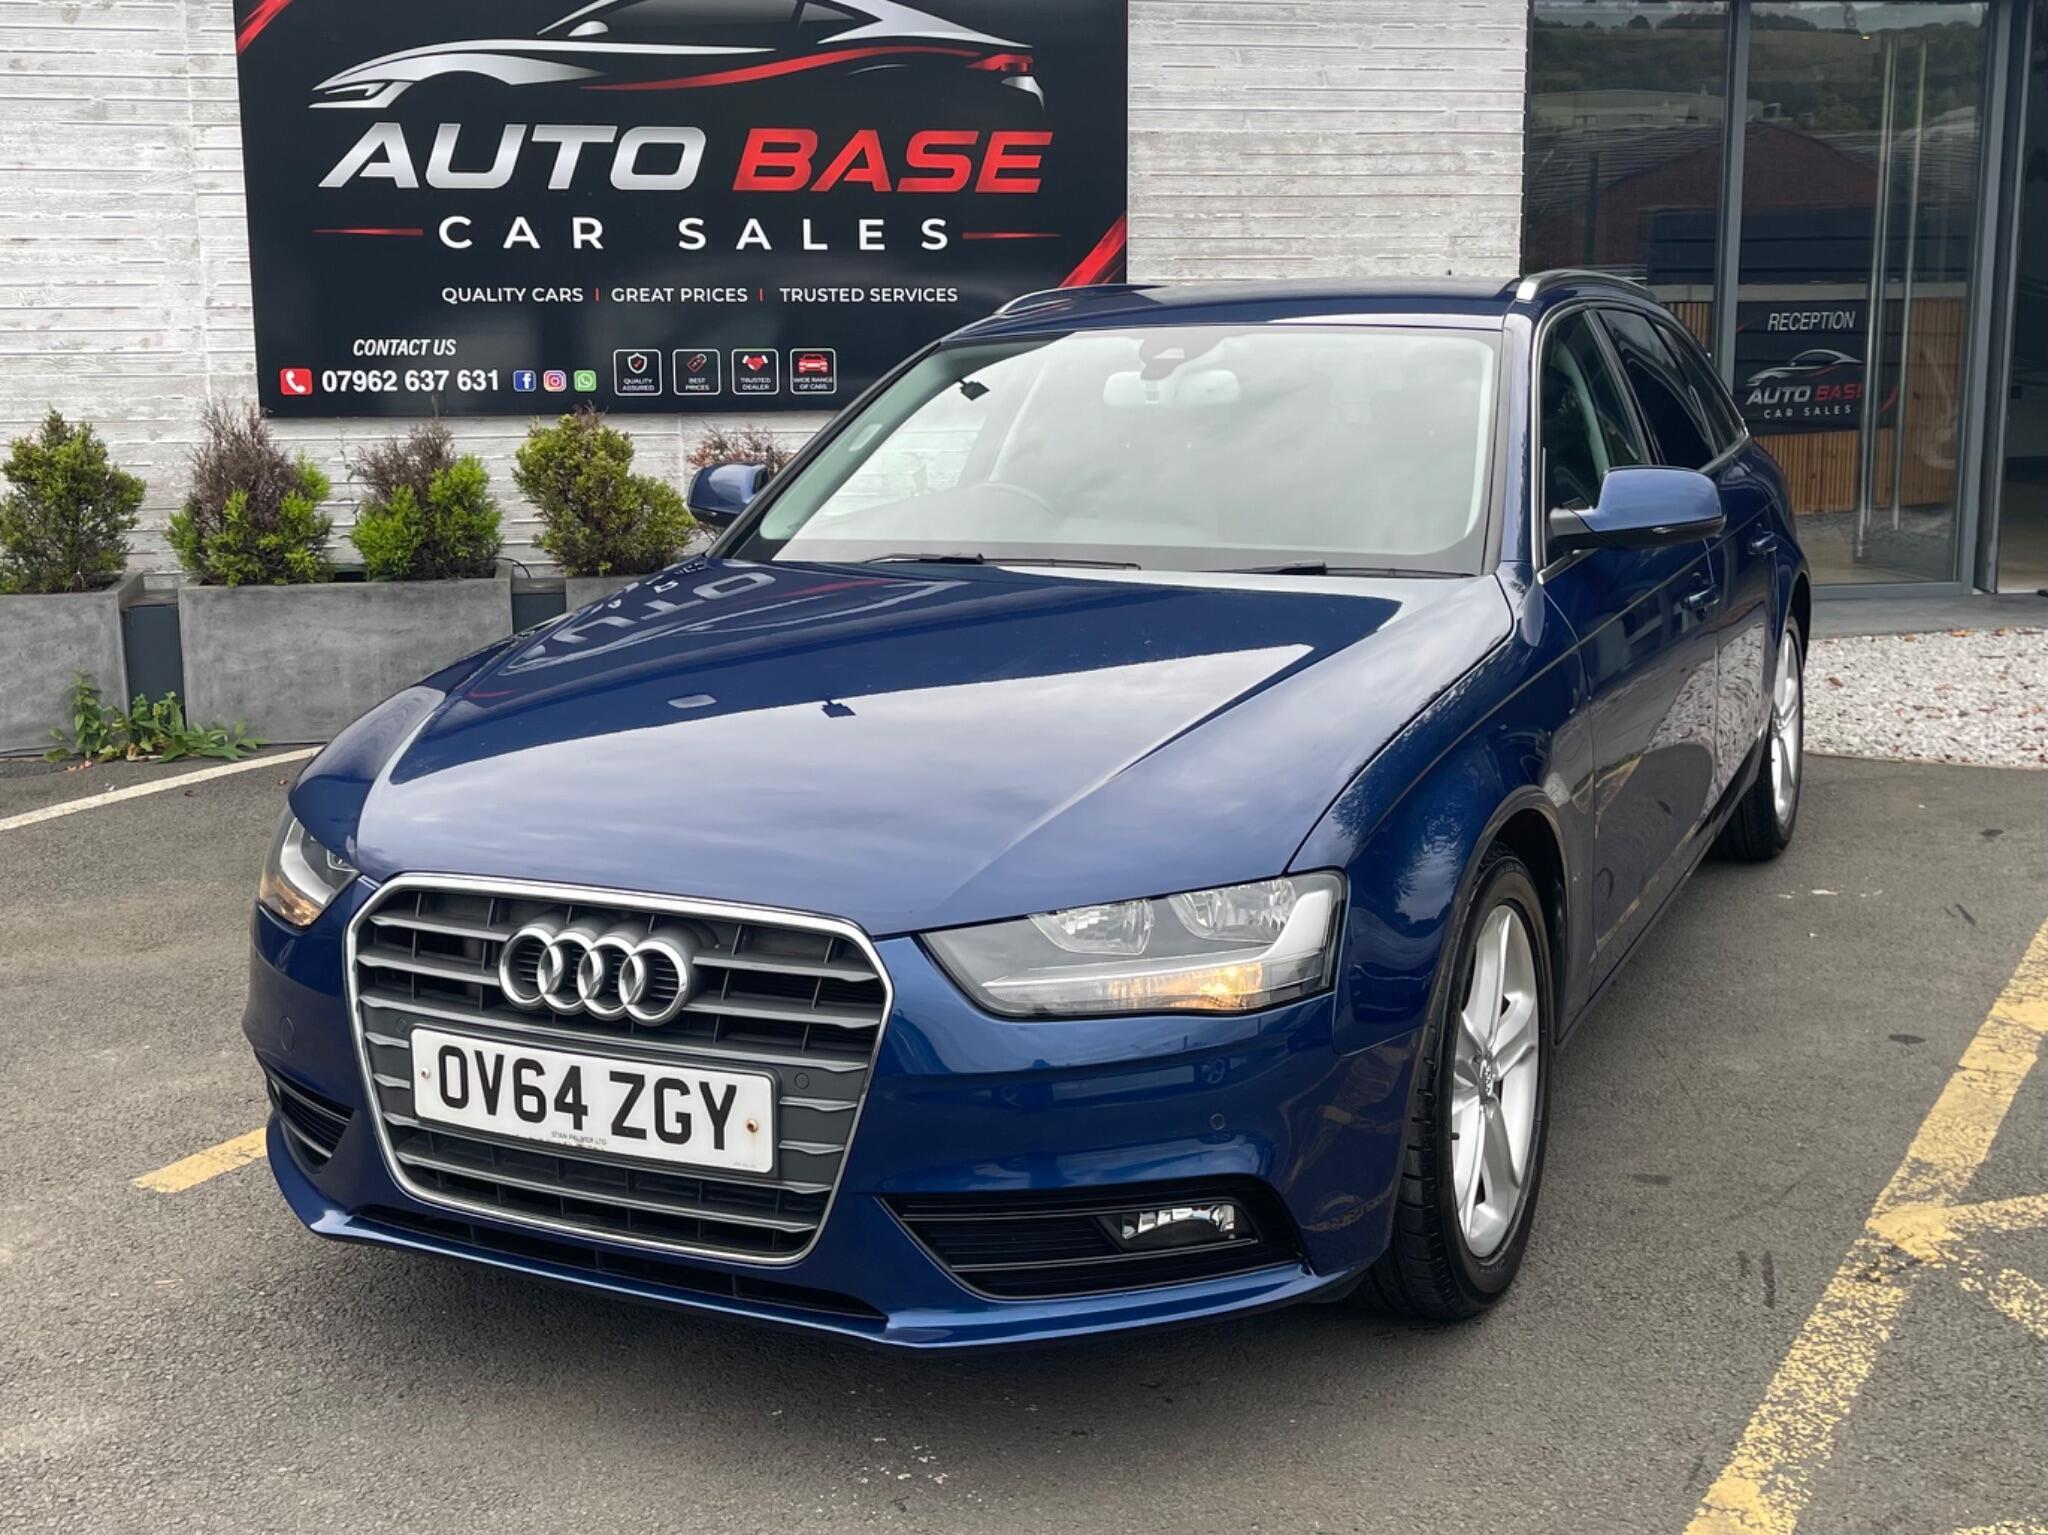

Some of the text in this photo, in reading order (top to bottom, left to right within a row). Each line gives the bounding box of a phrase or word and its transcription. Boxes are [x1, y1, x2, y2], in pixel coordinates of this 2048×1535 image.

[317, 122, 1054, 194] AUTO BASE
[438, 215, 950, 252] CAR SALES
[441, 287, 584, 304] QUALITY CARS
[611, 287, 749, 303] GREAT PRICES
[779, 287, 958, 303] TRUSTED SERVICES
[1767, 311, 1855, 331] RECEPTION
[353, 338, 457, 357] CONTACT US
[321, 369, 500, 392] 07962 637 631
[623, 377, 653, 385] QUALITY
[1746, 386, 1811, 405] AUTO
[1763, 404, 1852, 419] CAR SALES
[438, 1044, 738, 1150] OV64 ZGY
